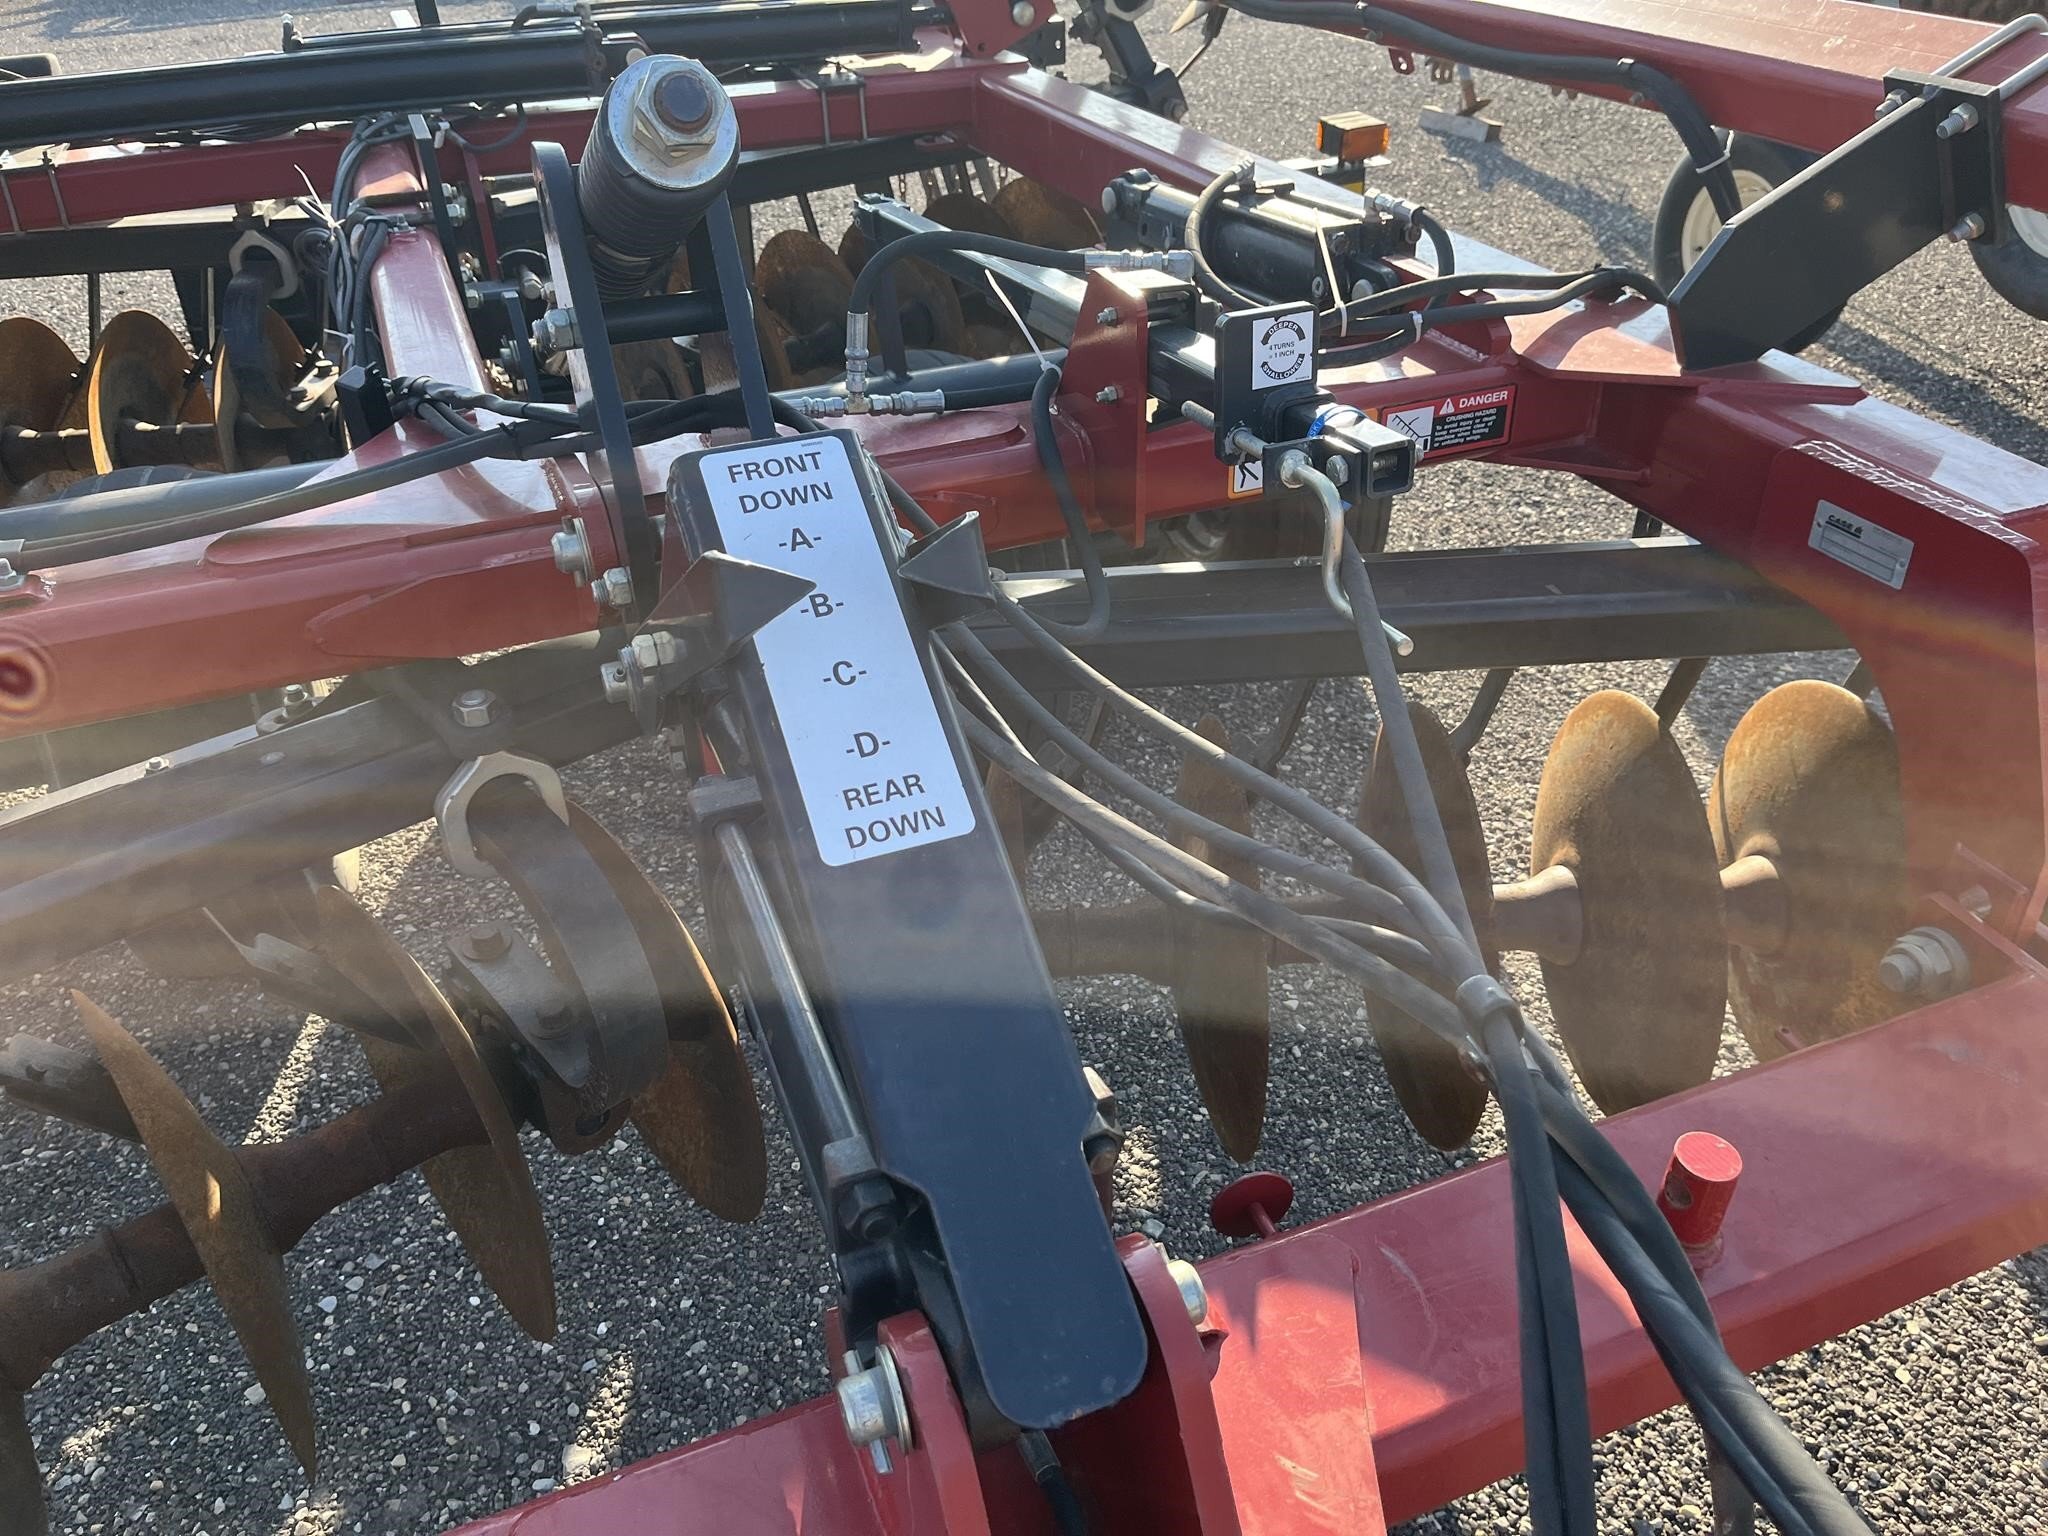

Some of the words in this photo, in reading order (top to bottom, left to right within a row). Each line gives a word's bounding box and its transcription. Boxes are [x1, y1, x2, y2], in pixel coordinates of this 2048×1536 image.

[1268, 321, 1299, 335] DEEPER
[1273, 341, 1295, 351] TURNS
[1279, 349, 1295, 358] INCH
[1262, 357, 1305, 379] SHALLOWER
[1459, 391, 1508, 408] DANGER
[1446, 413, 1474, 422] CRUSHING
[1475, 408, 1497, 416] HAZARD
[727, 451, 823, 484] FRONT
[738, 481, 834, 514] DOWN
[778, 527, 822, 552] -A-
[800, 592, 844, 618] -B-
[823, 660, 867, 686] -C-
[846, 731, 891, 758] -D-
[842, 773, 926, 811] REAR
[844, 806, 946, 849] DOWN
